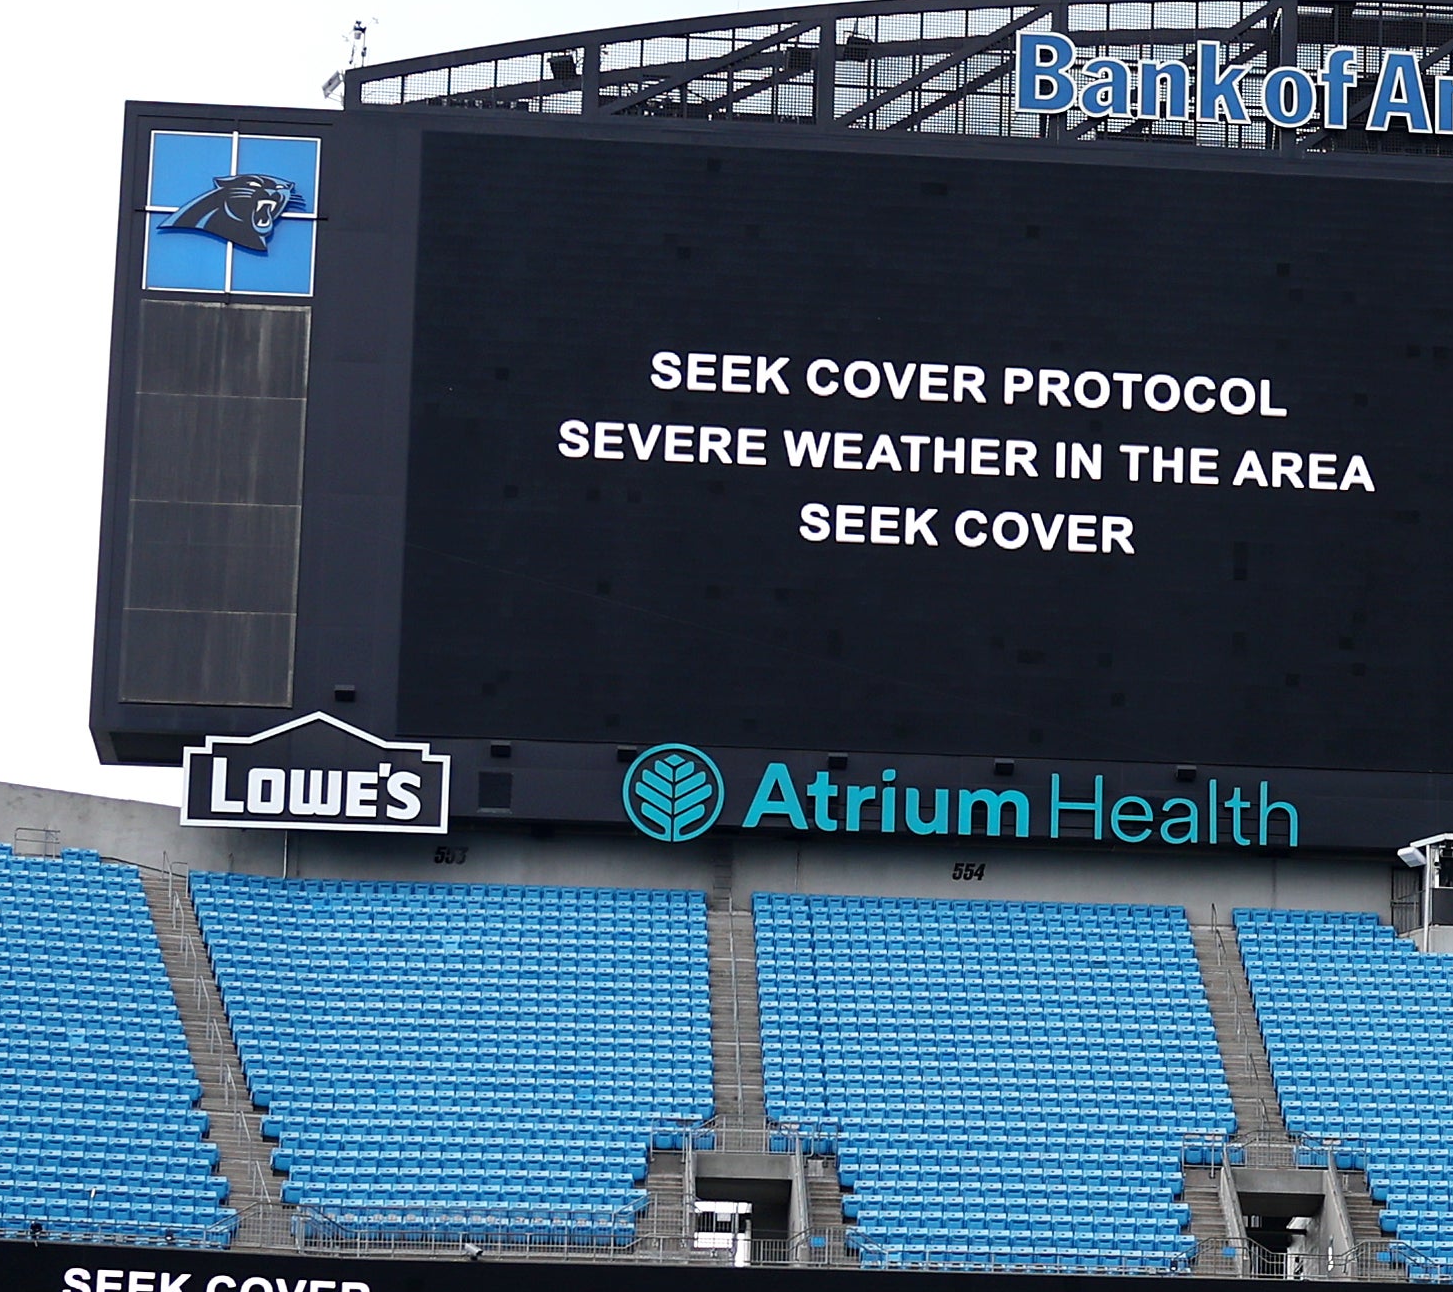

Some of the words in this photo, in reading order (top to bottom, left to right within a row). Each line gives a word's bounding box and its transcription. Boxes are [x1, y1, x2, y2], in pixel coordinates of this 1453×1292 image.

[1013, 29, 1249, 119] Bank
[1264, 41, 1358, 128] of
[651, 352, 789, 394] SEEK
[807, 359, 986, 403] COVER
[1004, 368, 1287, 416] PROTOCOL
[559, 420, 766, 465] SEVERE
[784, 430, 1038, 477] WEATHER
[1056, 442, 1101, 479] IN
[1120, 445, 1218, 484] THE
[1233, 451, 1374, 491] AREA
[800, 504, 938, 545] SEEK
[955, 510, 1134, 554] COVER
[211, 758, 422, 822] LOWE'S
[744, 763, 1029, 837] Atrium
[1051, 774, 1298, 846] Health
[951, 862, 987, 883] 554
